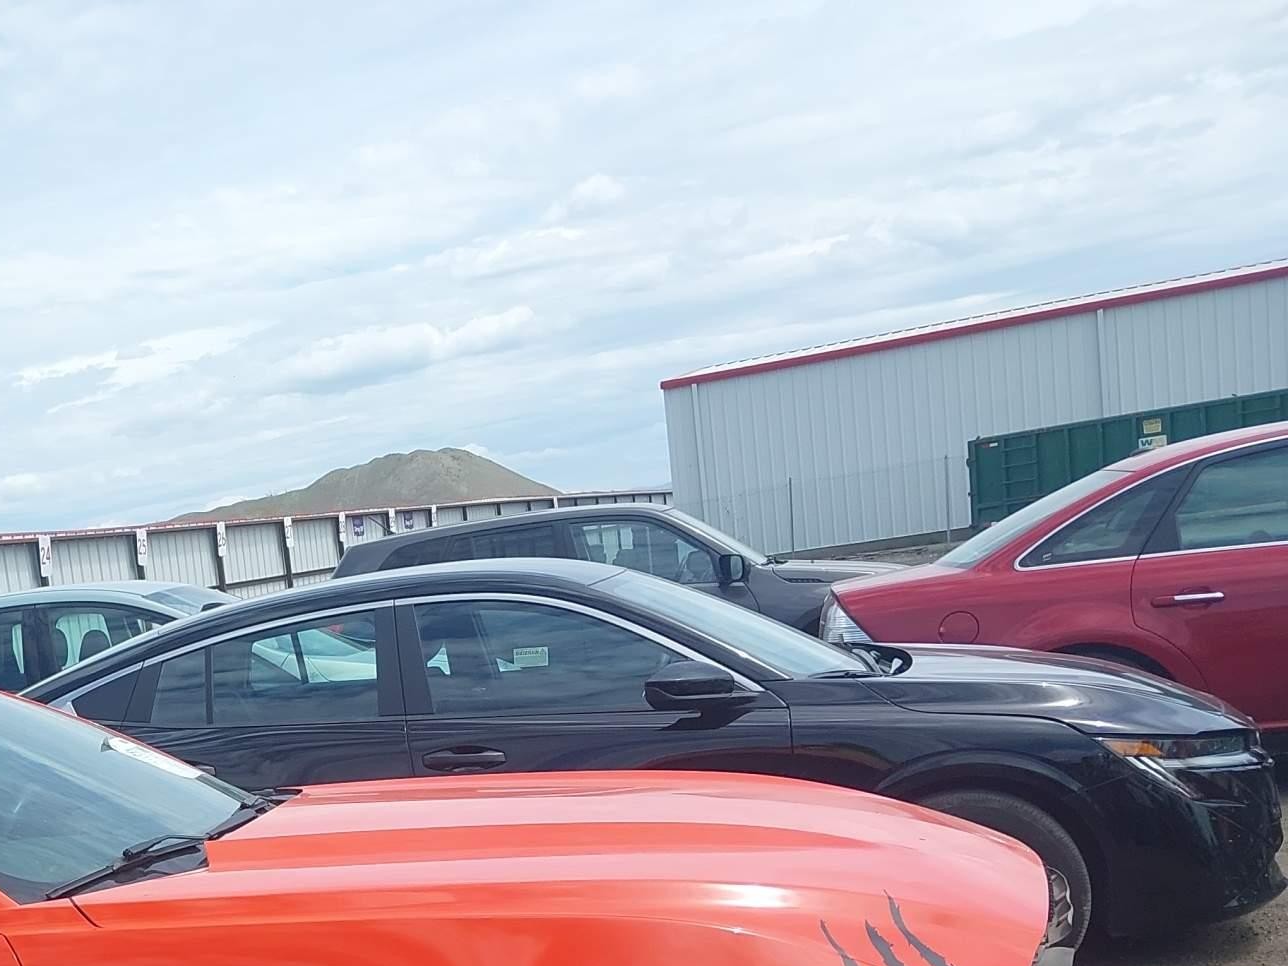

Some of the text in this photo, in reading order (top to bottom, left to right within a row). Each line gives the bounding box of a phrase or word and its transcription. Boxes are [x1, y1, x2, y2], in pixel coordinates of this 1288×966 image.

[138, 538, 146, 555] 25
[218, 531, 226, 547] 26
[41, 545, 51, 565] 24
